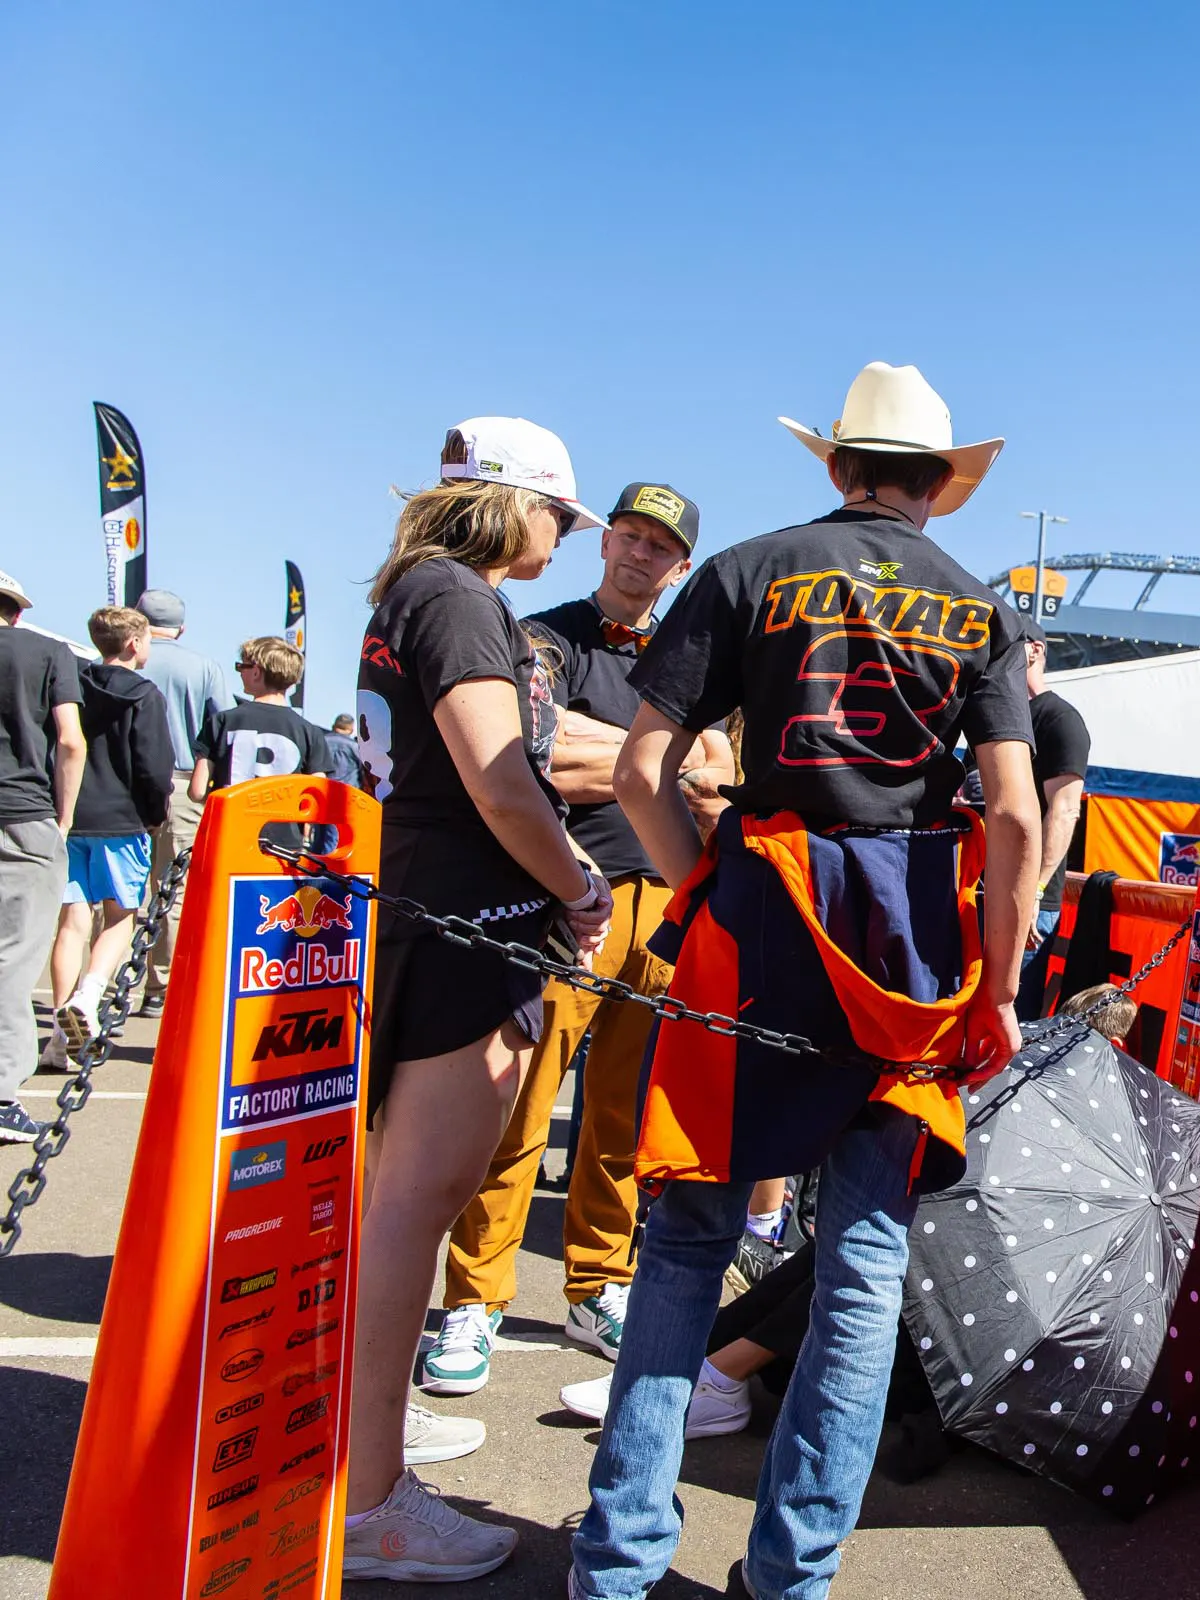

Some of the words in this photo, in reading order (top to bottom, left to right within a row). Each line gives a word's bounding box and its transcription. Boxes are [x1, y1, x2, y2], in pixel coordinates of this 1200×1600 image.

[859, 558, 904, 580] SMX
[764, 569, 994, 650] TOMAC
[1018, 594, 1030, 610] 6
[1045, 597, 1056, 613] 6
[238, 941, 304, 992] Red
[307, 938, 361, 986] Bull
[251, 1008, 344, 1062] KTM
[228, 1085, 301, 1121] FACTORY
[304, 1074, 354, 1102] RACING
[302, 1136, 348, 1165] WP
[233, 1159, 283, 1182] MOTOREX
[224, 1216, 284, 1243] PROGRESSIVE
[217, 1394, 263, 1422] OGIO
[219, 1434, 255, 1460] ETS
